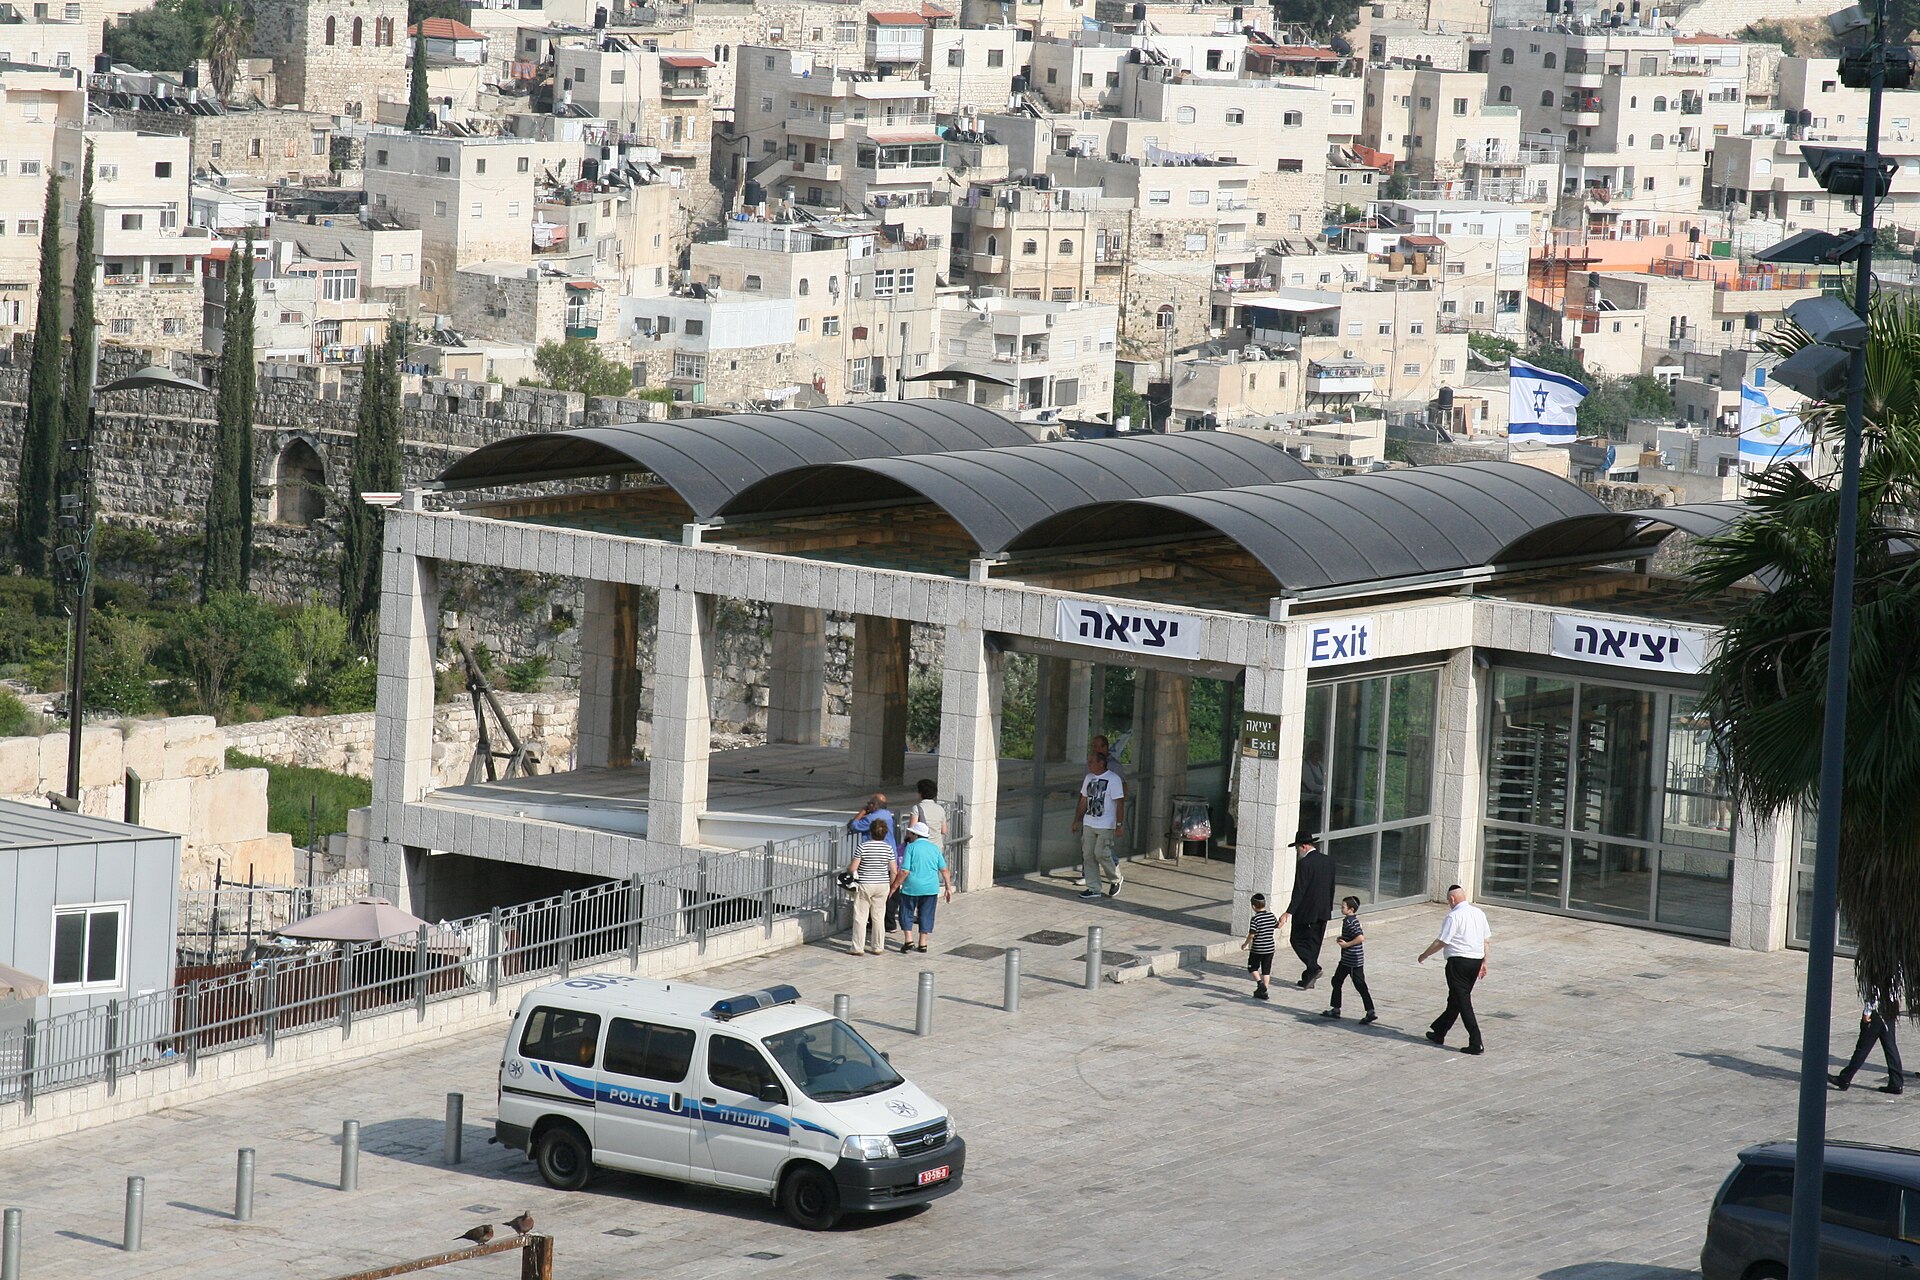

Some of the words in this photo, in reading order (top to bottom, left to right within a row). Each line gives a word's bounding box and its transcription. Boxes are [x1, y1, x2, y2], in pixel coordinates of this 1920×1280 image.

[1079, 609, 1179, 647] יציאה
[1311, 625, 1367, 662] Exit
[1574, 624, 1679, 663] יציאה
[1246, 719, 1272, 734] יציאה
[1251, 737, 1277, 752] Exit
[609, 1087, 660, 1109] POLICE
[719, 1108, 771, 1129] משטרה
